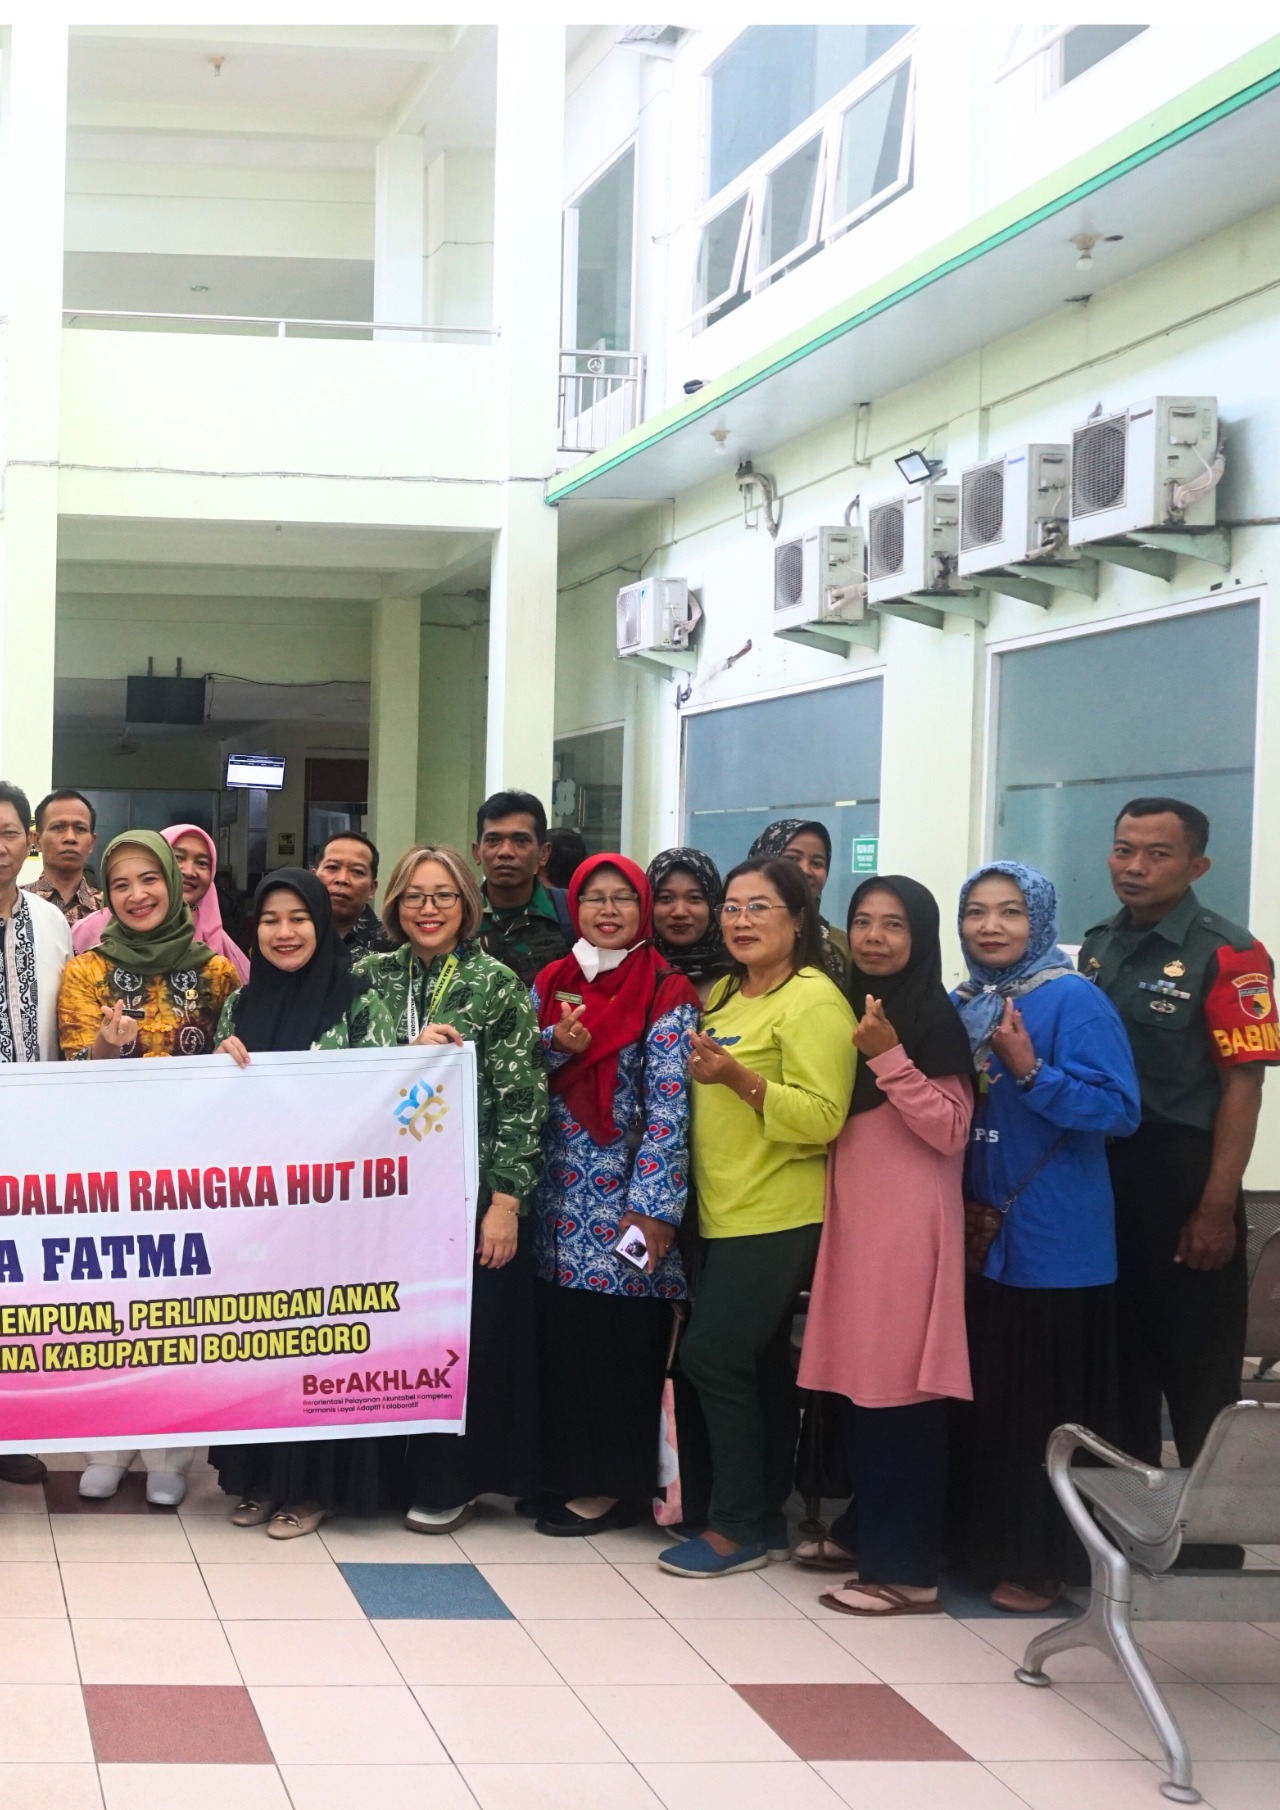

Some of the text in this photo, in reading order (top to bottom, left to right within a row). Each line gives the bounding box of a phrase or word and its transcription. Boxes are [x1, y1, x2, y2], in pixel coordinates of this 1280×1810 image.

[129, 1165, 278, 1211] RANGKA
[286, 1161, 355, 1205] HUT
[362, 1155, 409, 1198] IBI
[42, 1232, 212, 1282] FATMA
[128, 1287, 326, 1331] PERLINDUNGAN
[328, 1281, 400, 1314] ANAK
[42, 1333, 199, 1373] KABUPATEN
[201, 1321, 370, 1364] BOJONEGORO
[303, 1367, 452, 1396] BerAKHLAK
[303, 1393, 453, 1406] Berorientasi Pelayanan Akuntabel Kompeten
[337, 1405, 356, 1413] Loyal
[356, 1403, 381, 1412] Adaptif
[382, 1401, 419, 1410] Kolaboratif
